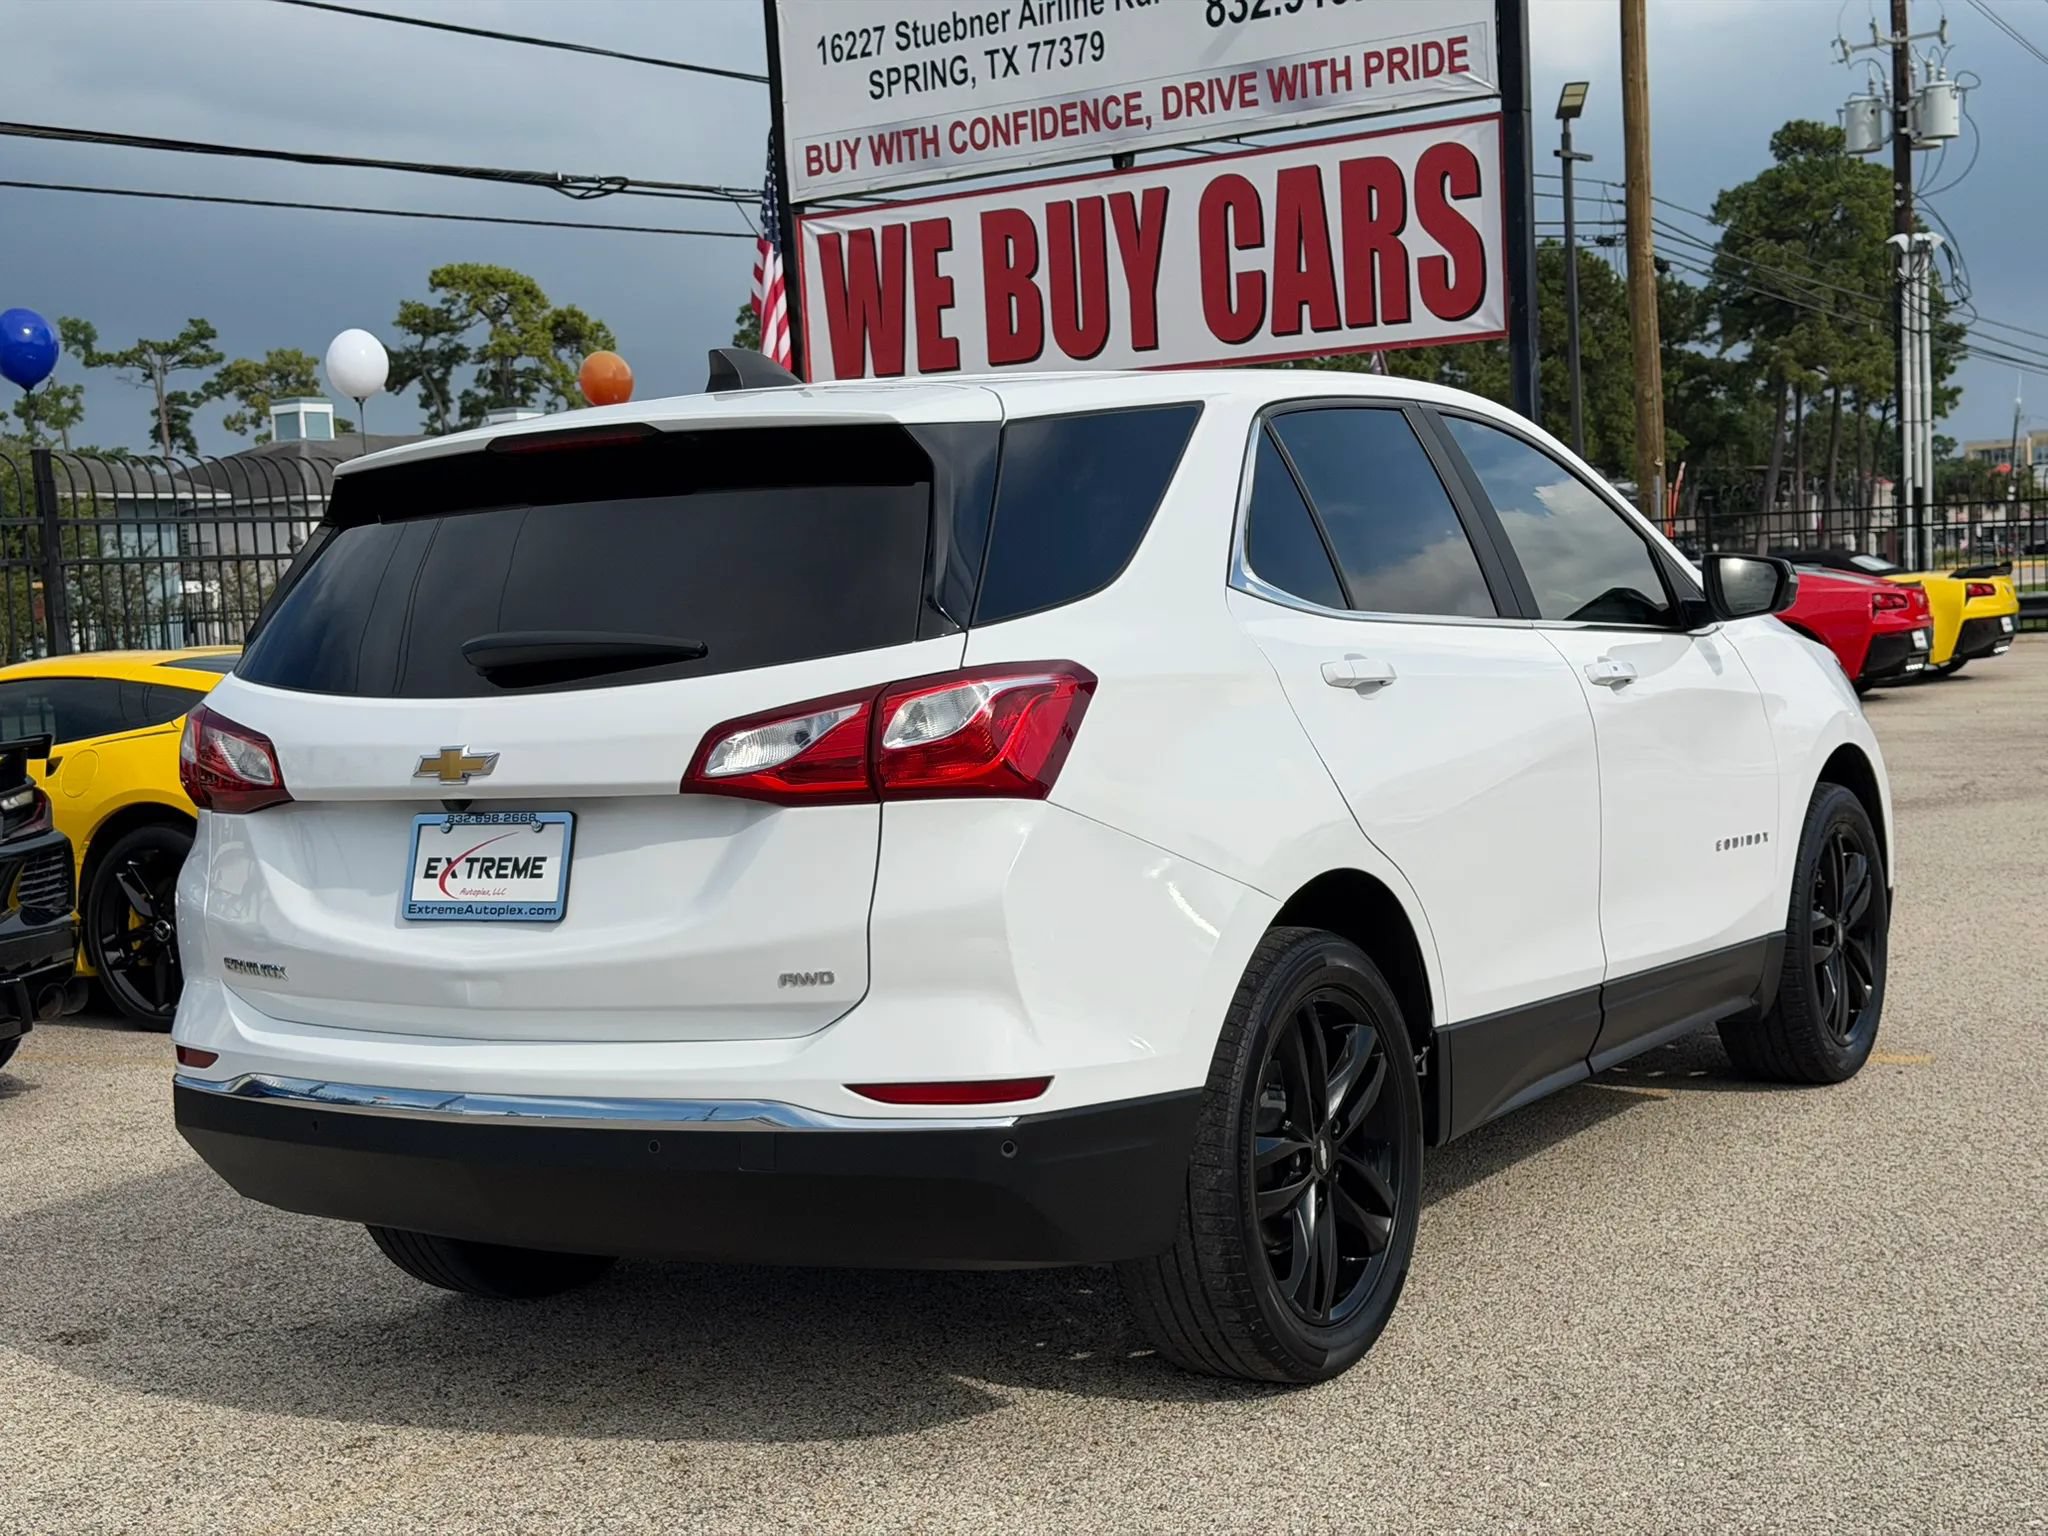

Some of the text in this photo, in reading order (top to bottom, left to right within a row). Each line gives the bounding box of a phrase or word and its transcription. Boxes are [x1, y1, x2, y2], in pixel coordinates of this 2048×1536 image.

[816, 0, 1105, 66] 16227 Stuebner Airline
[868, 30, 1106, 101] SPRING, TX 77379
[805, 35, 1471, 177] BUY WITH CONFIDENCE, DRIVE WITH PRIDE
[816, 141, 1488, 380] WE BUY CARS
[422, 856, 548, 880] EXTREME
[407, 903, 557, 917] ExtremeAutoplex.com
[777, 970, 836, 989] AWD
